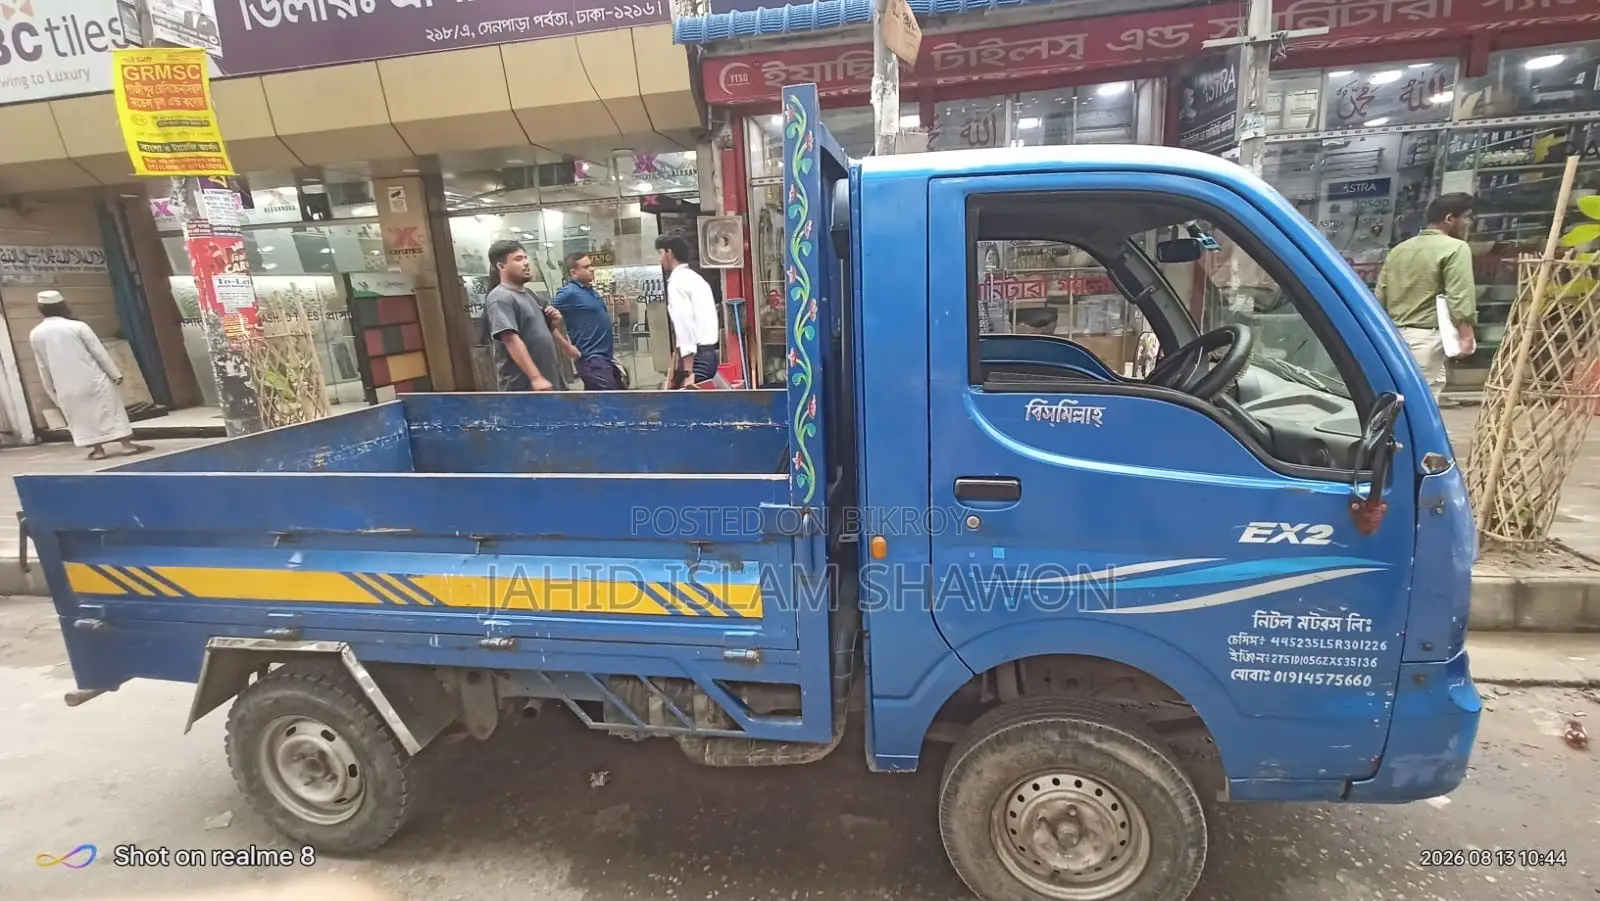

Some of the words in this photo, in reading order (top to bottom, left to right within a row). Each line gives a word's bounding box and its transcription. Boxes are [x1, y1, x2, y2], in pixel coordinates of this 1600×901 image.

[478, 16, 530, 36] সেনপাড়া
[31, 73, 45, 86] to
[46, 67, 91, 84] Luxury
[123, 64, 201, 81] GRMSC
[1238, 521, 1335, 545] EX2
[1252, 609, 1294, 630] নিটল
[1297, 610, 1344, 633] মটরস
[1273, 670, 1373, 688] 01914575660
